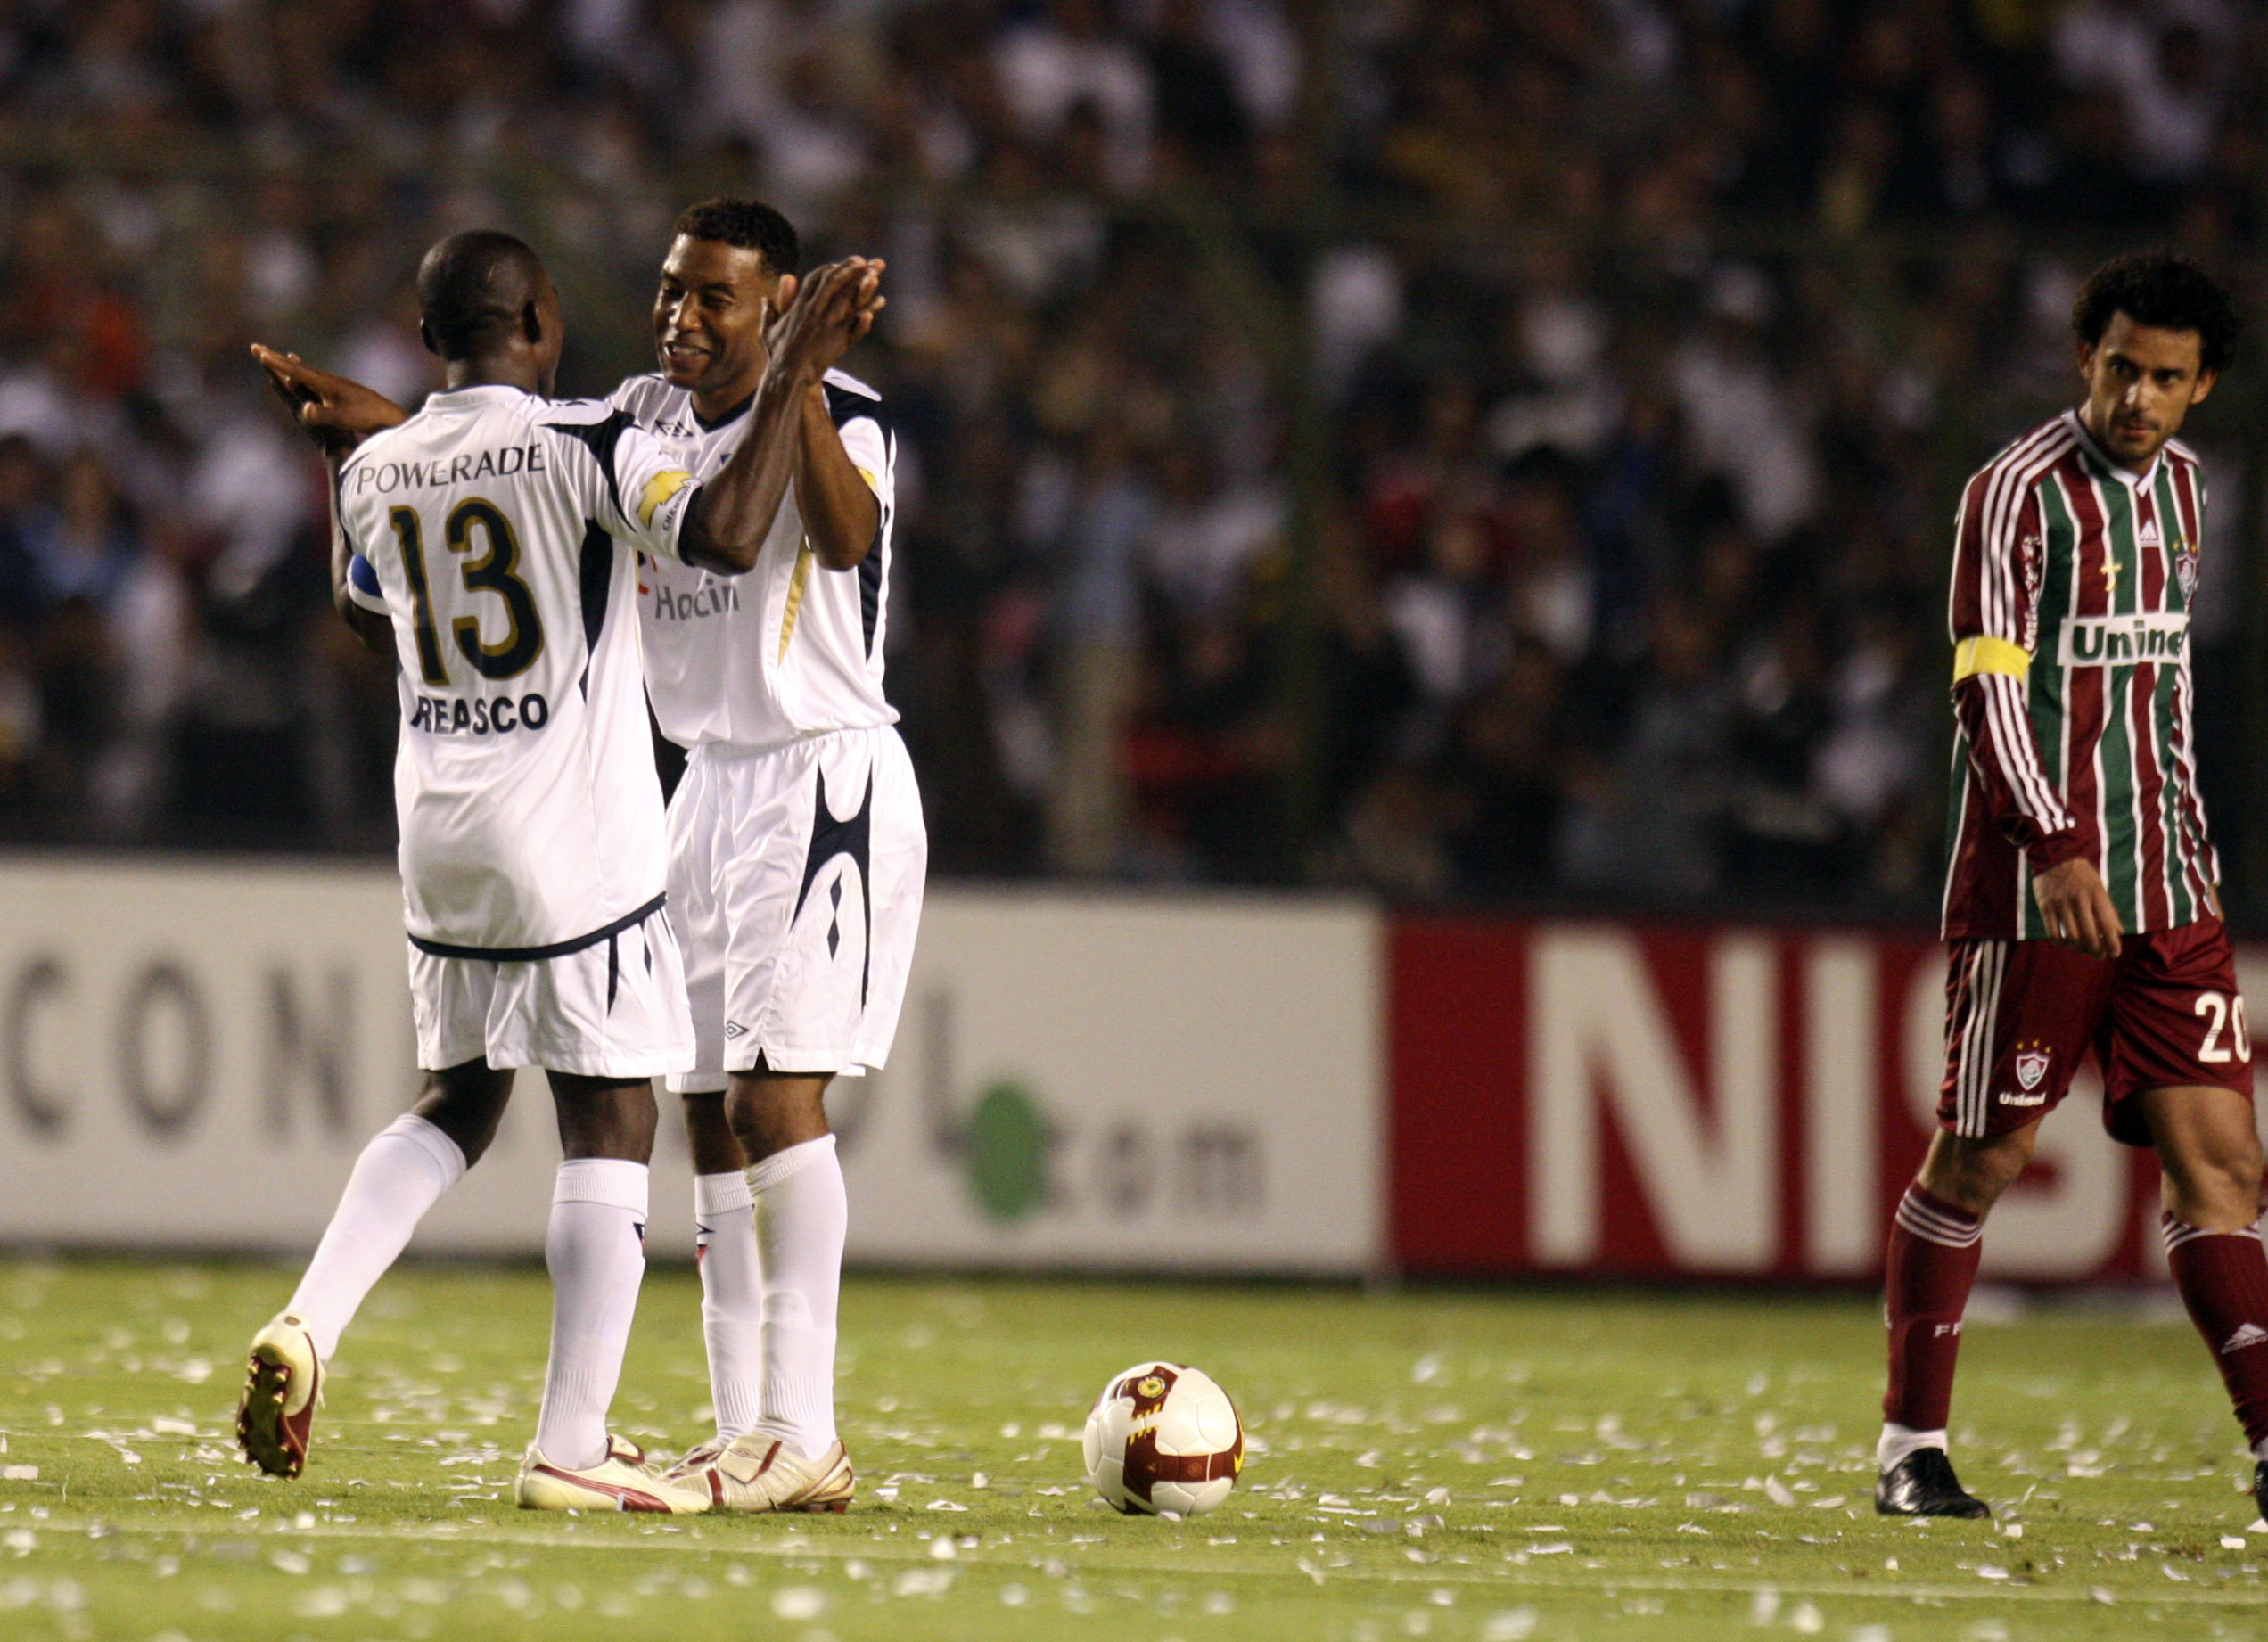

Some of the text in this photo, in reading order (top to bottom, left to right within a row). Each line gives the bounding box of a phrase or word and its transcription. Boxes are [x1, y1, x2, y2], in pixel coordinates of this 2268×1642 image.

[357, 443, 546, 494] POWERADE
[388, 496, 545, 686] 13
[410, 693, 549, 735] REASCO
[2194, 991, 2251, 1063] 20
[1523, 920, 2268, 1284] NIS
